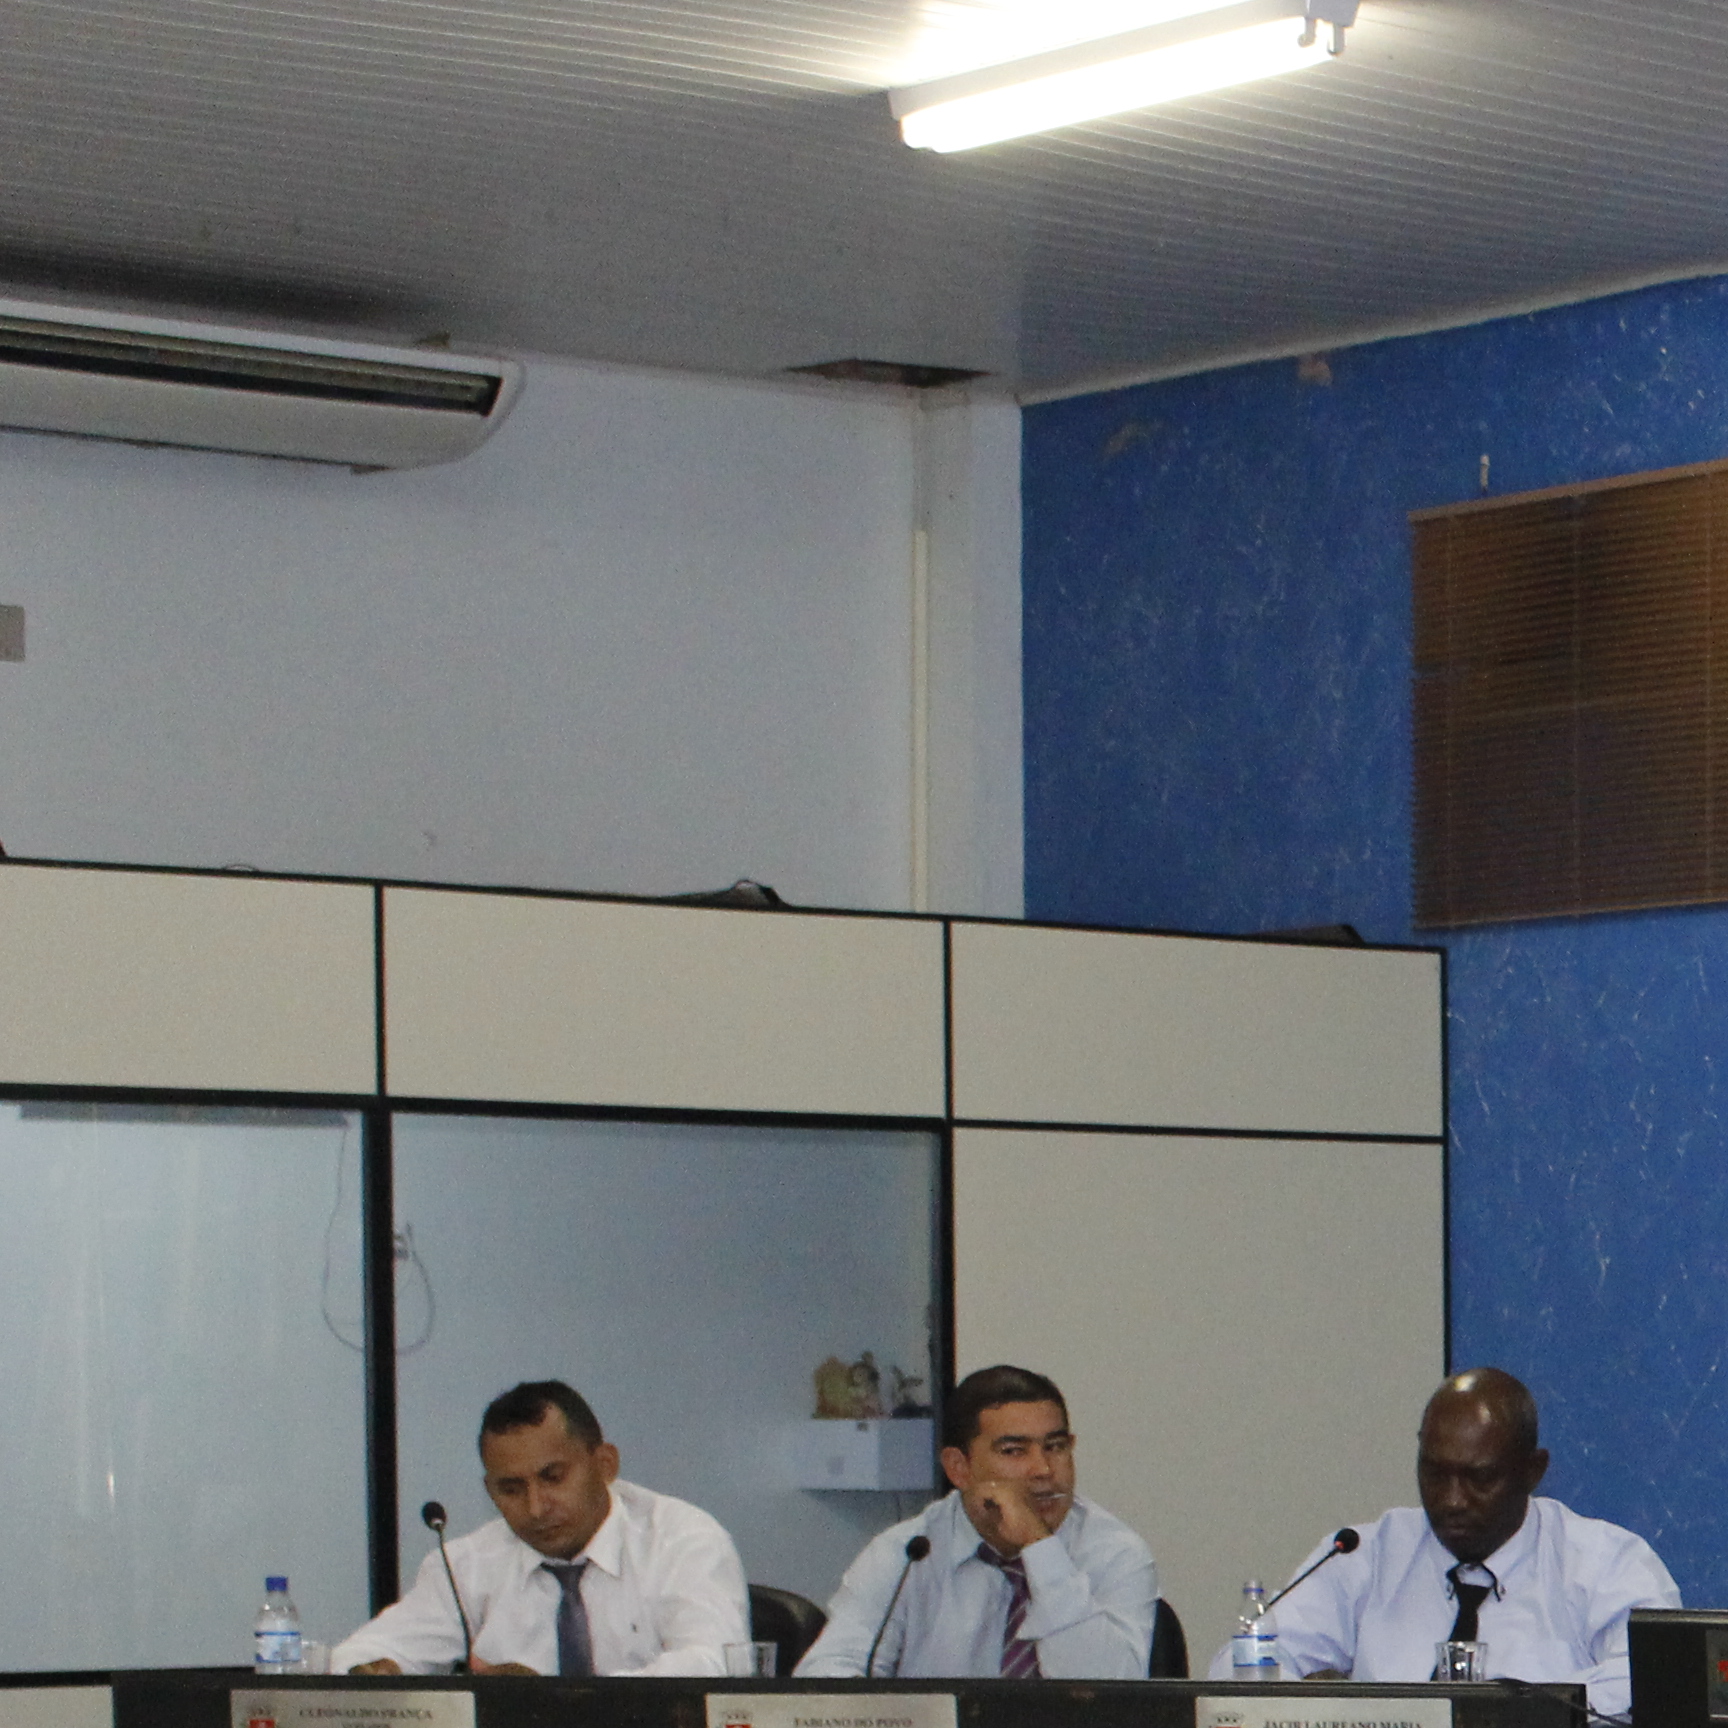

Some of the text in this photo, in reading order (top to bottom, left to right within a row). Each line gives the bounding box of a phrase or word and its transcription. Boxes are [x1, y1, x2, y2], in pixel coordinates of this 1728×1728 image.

[794, 1717, 913, 1728] FABIANO DO POVO
